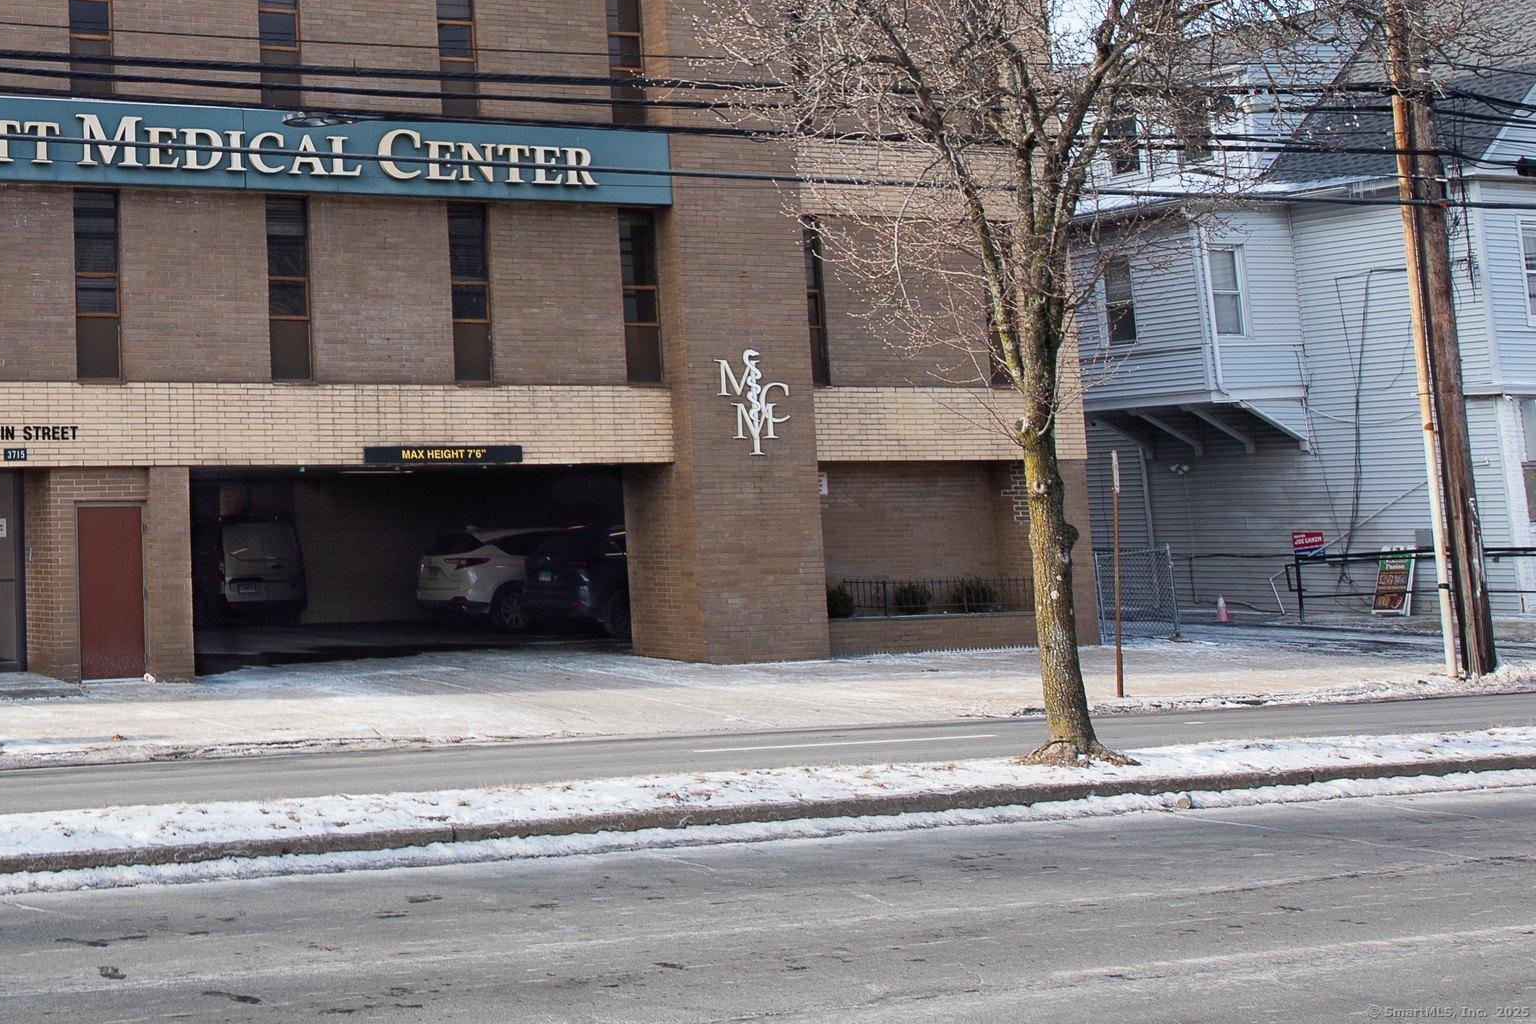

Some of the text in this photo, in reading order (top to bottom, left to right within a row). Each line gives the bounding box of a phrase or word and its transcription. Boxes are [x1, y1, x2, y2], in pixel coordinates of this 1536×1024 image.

[75, 113, 363, 178] MEDICAL
[377, 128, 600, 186] CENTER
[23, 426, 78, 440] STREET
[7, 450, 25, 459] 3715
[402, 450, 425, 459] MAX
[427, 450, 465, 459] HEIGHT
